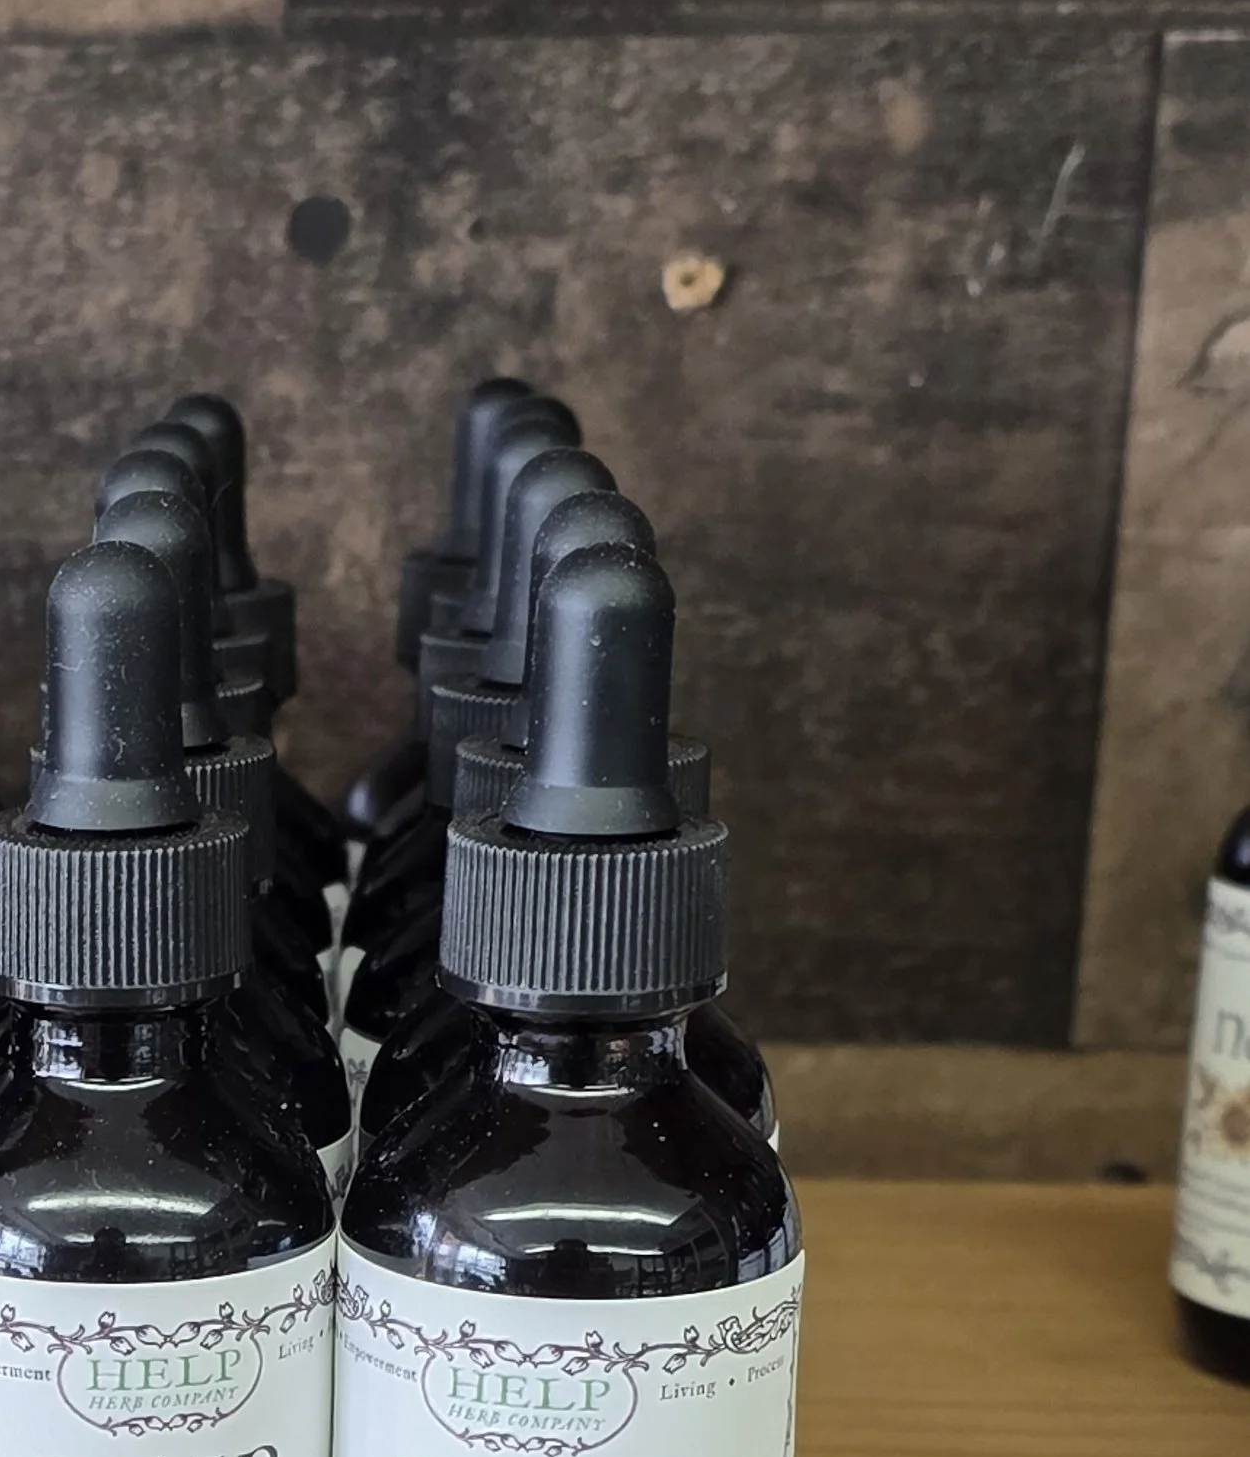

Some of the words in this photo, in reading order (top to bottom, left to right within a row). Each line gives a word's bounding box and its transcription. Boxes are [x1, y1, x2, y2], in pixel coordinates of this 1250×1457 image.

[86, 1348, 242, 1392] HELP
[89, 1395, 144, 1413] HERB
[151, 1385, 240, 1409] COMPANY
[447, 1366, 612, 1412] HELP
[659, 1380, 717, 1401] Living
[447, 1403, 501, 1428] HERB
[507, 1413, 607, 1432] COMPANY
